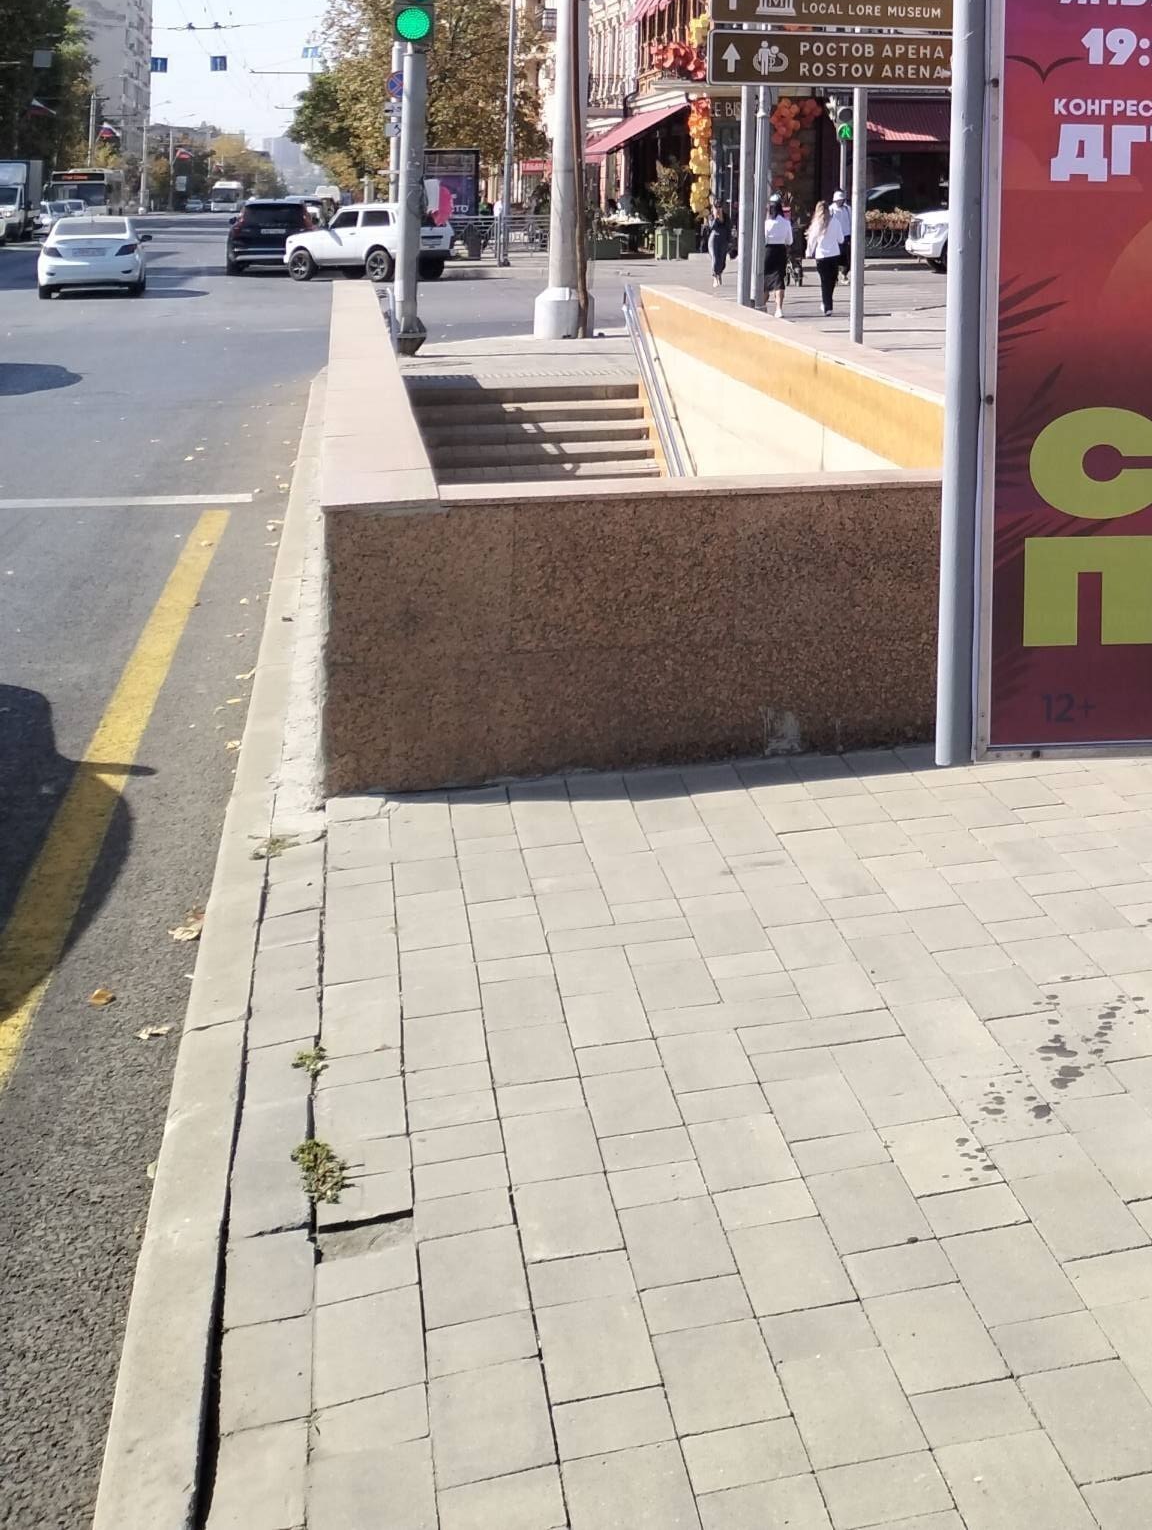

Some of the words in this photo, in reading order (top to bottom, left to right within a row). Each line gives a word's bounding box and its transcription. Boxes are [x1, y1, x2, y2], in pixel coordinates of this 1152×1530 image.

[801, 2, 844, 15] LOCAL
[848, 4, 881, 17] LORE
[887, 7, 942, 19] MUSEUM
[799, 42, 875, 57] РОСТОВ
[881, 44, 945, 59] АРЕНА
[799, 62, 874, 78] ROSTOV
[881, 64, 944, 79] ARENA
[1041, 693, 1097, 724] 12+
